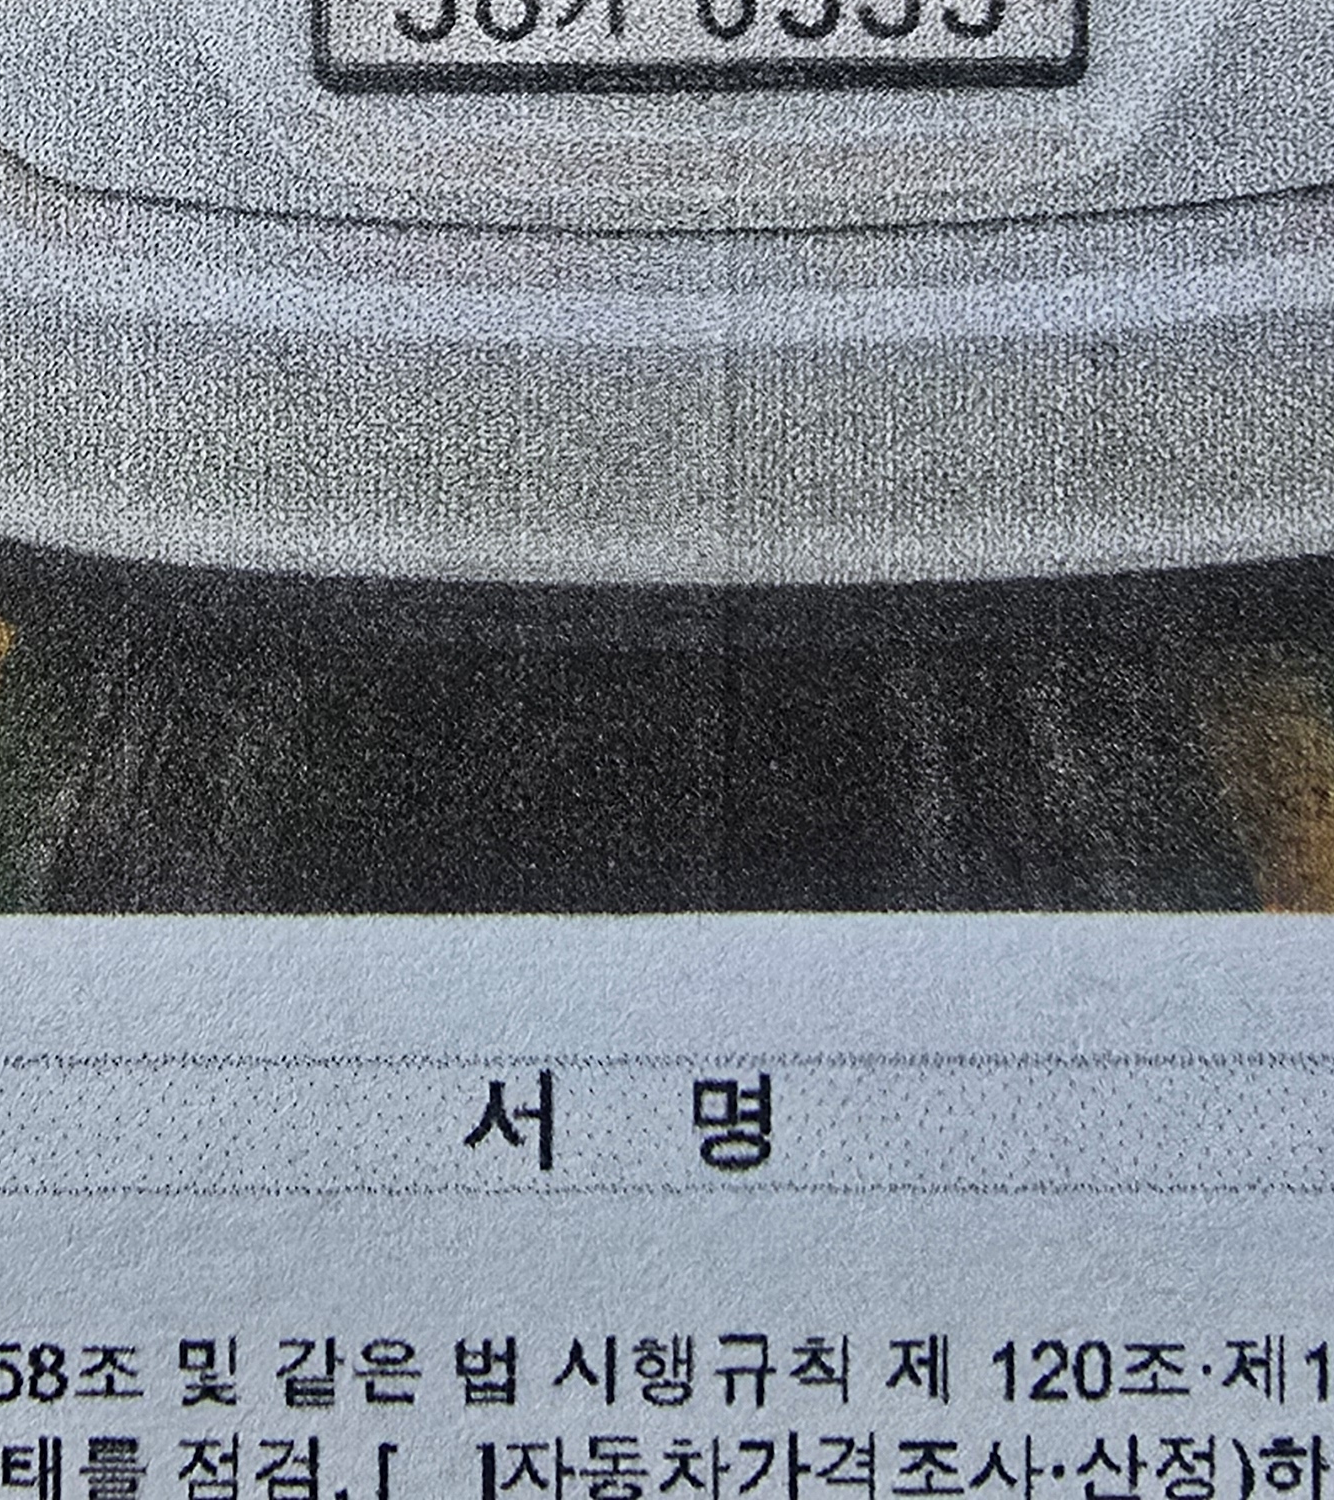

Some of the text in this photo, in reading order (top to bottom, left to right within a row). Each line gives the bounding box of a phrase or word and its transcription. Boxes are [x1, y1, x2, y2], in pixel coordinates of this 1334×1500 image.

[178, 1335, 238, 1407] 및
[275, 1335, 423, 1408] 같은
[453, 1335, 517, 1407] 법
[884, 1333, 952, 1405] 제
